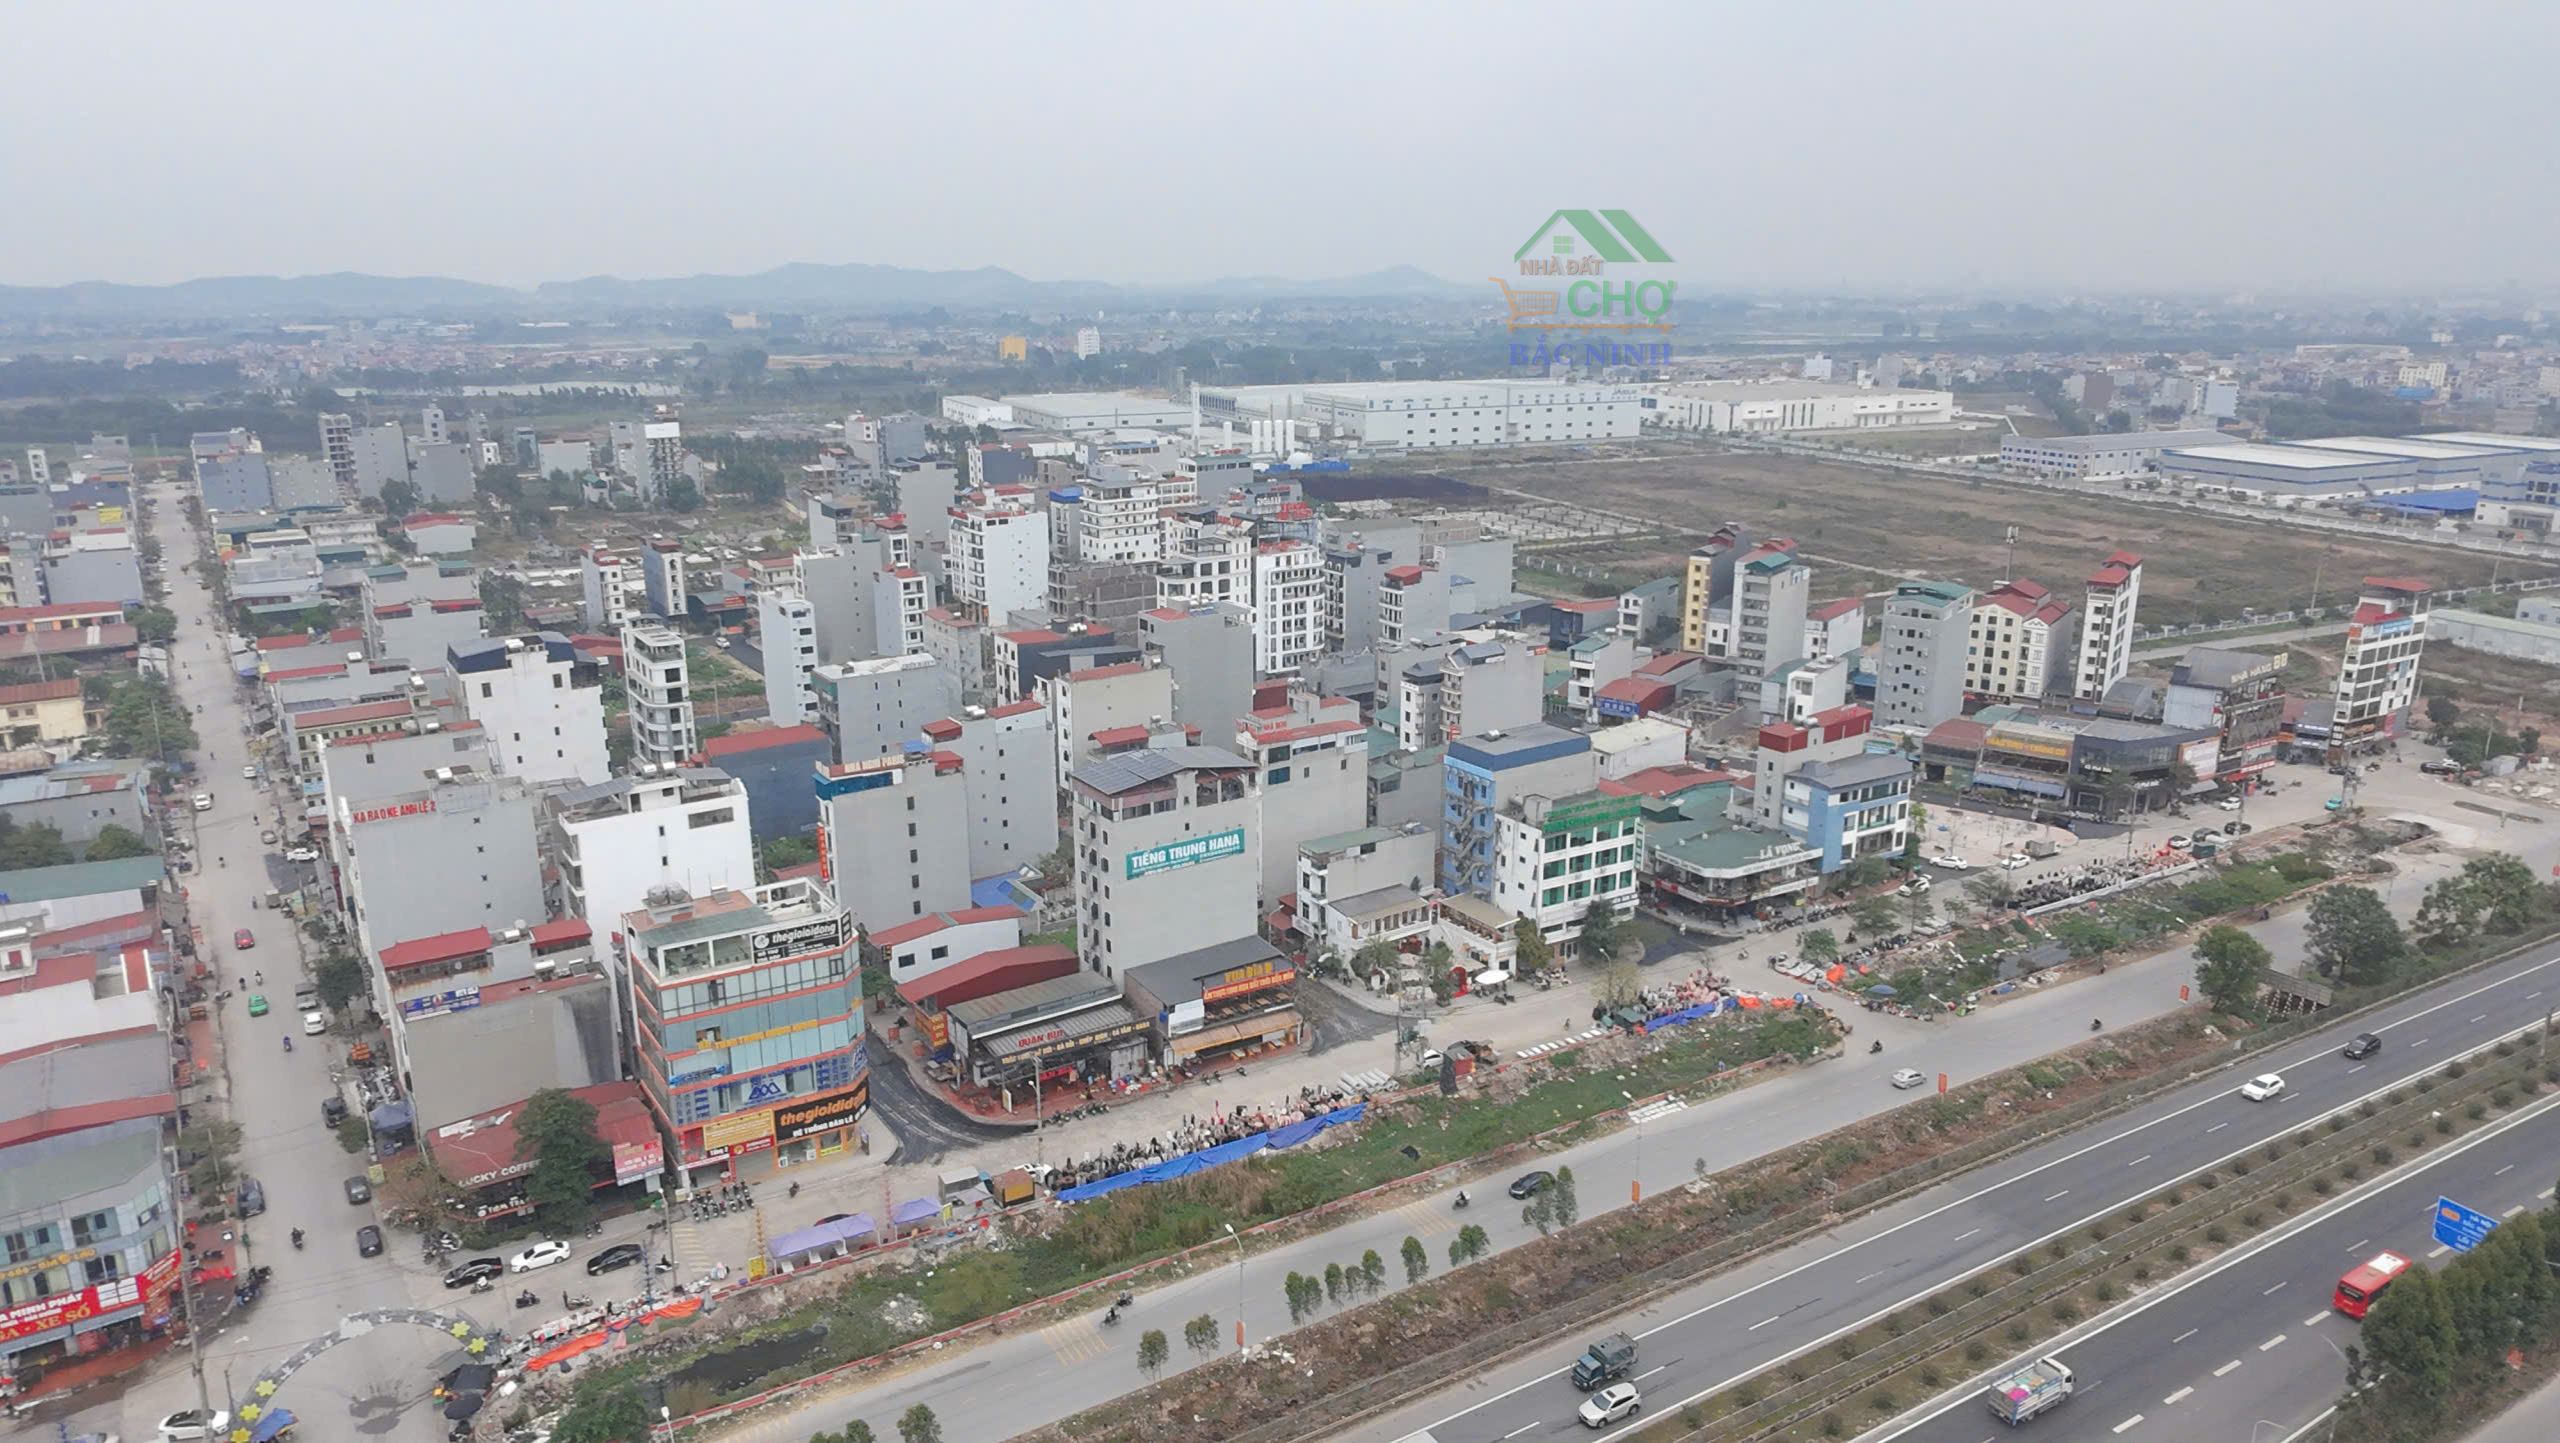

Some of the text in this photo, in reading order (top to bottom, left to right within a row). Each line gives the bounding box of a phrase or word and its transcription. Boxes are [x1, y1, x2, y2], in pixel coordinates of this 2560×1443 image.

[430, 801, 436, 812] 2
[1132, 849, 1166, 868] TIẾNG
[1169, 841, 1206, 860] TRUNG
[1209, 833, 1240, 851] HANA
[459, 1171, 497, 1187] LUCKY
[10, 1302, 46, 1319] MINH
[48, 1292, 83, 1309] PHÁT
[36, 1316, 61, 1331] XE
[65, 1302, 91, 1323] SỐ
